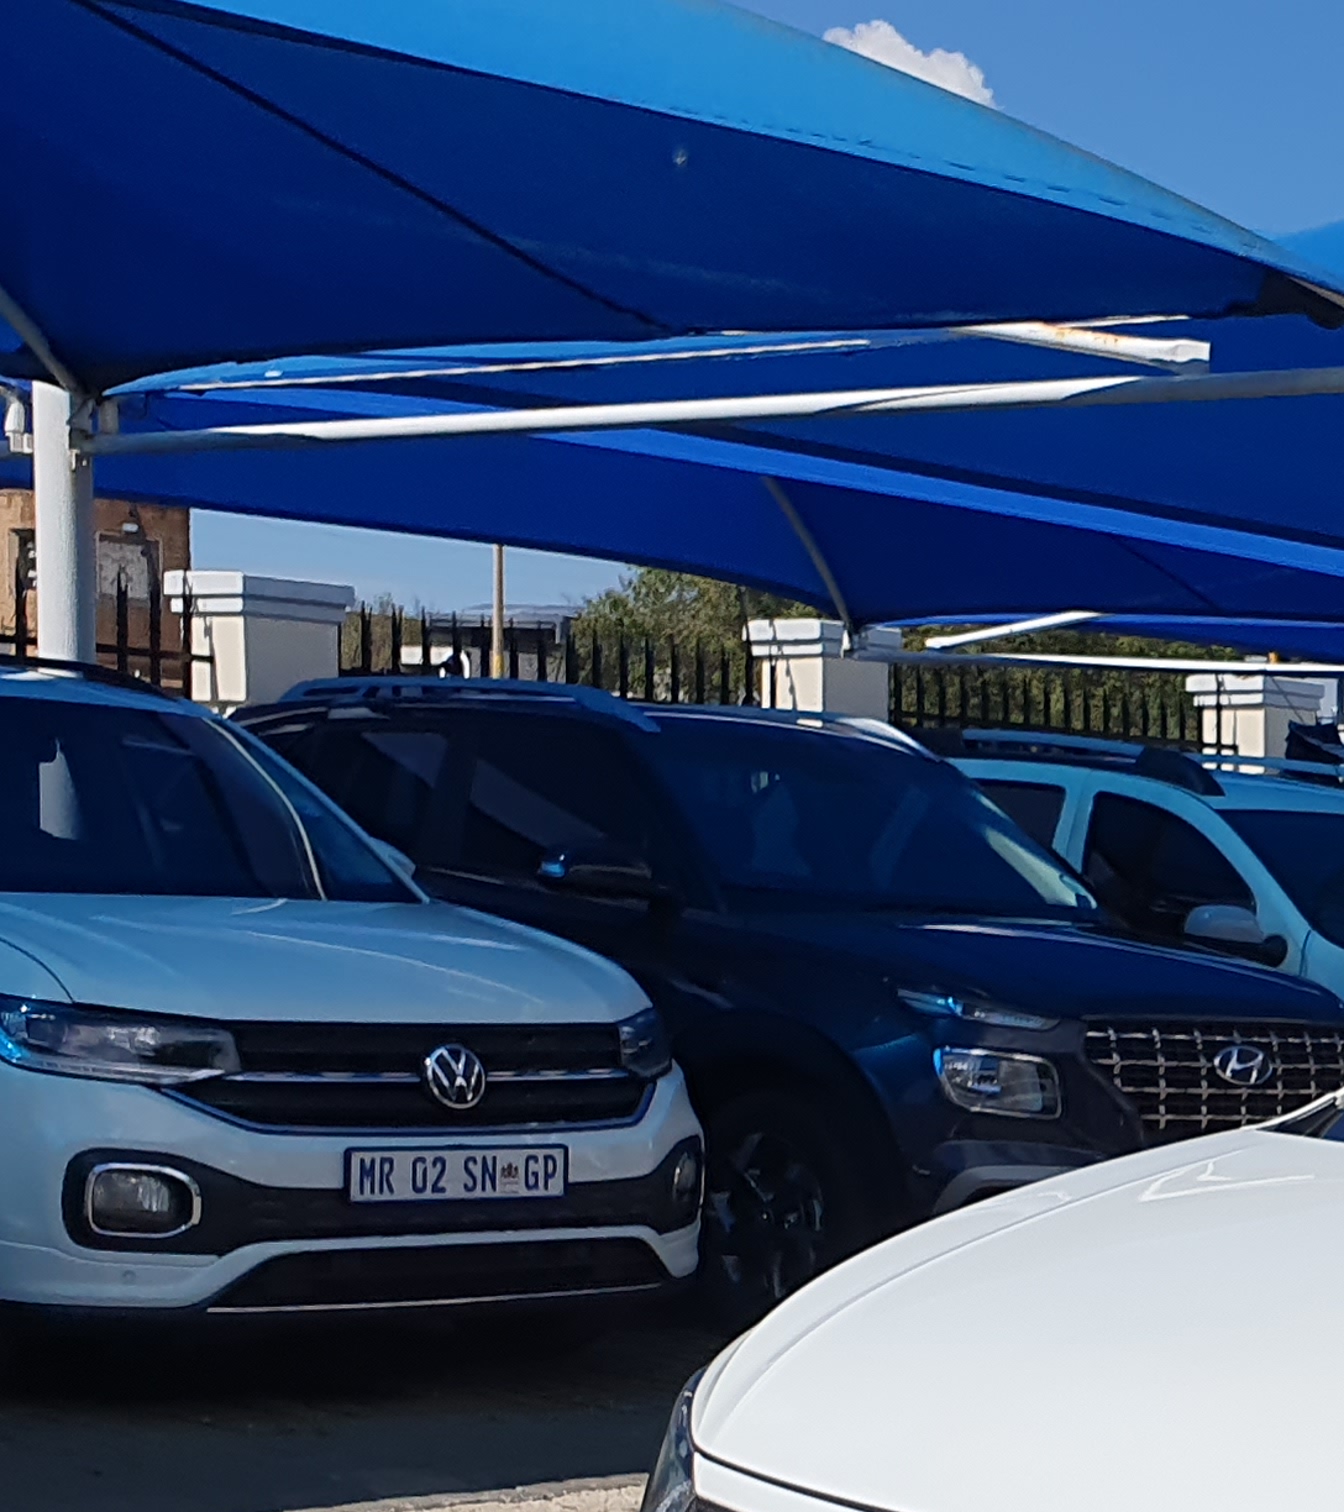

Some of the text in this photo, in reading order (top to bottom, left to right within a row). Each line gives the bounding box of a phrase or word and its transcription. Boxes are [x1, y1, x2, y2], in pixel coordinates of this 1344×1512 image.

[358, 1154, 558, 1195] MR 02 SN GP
